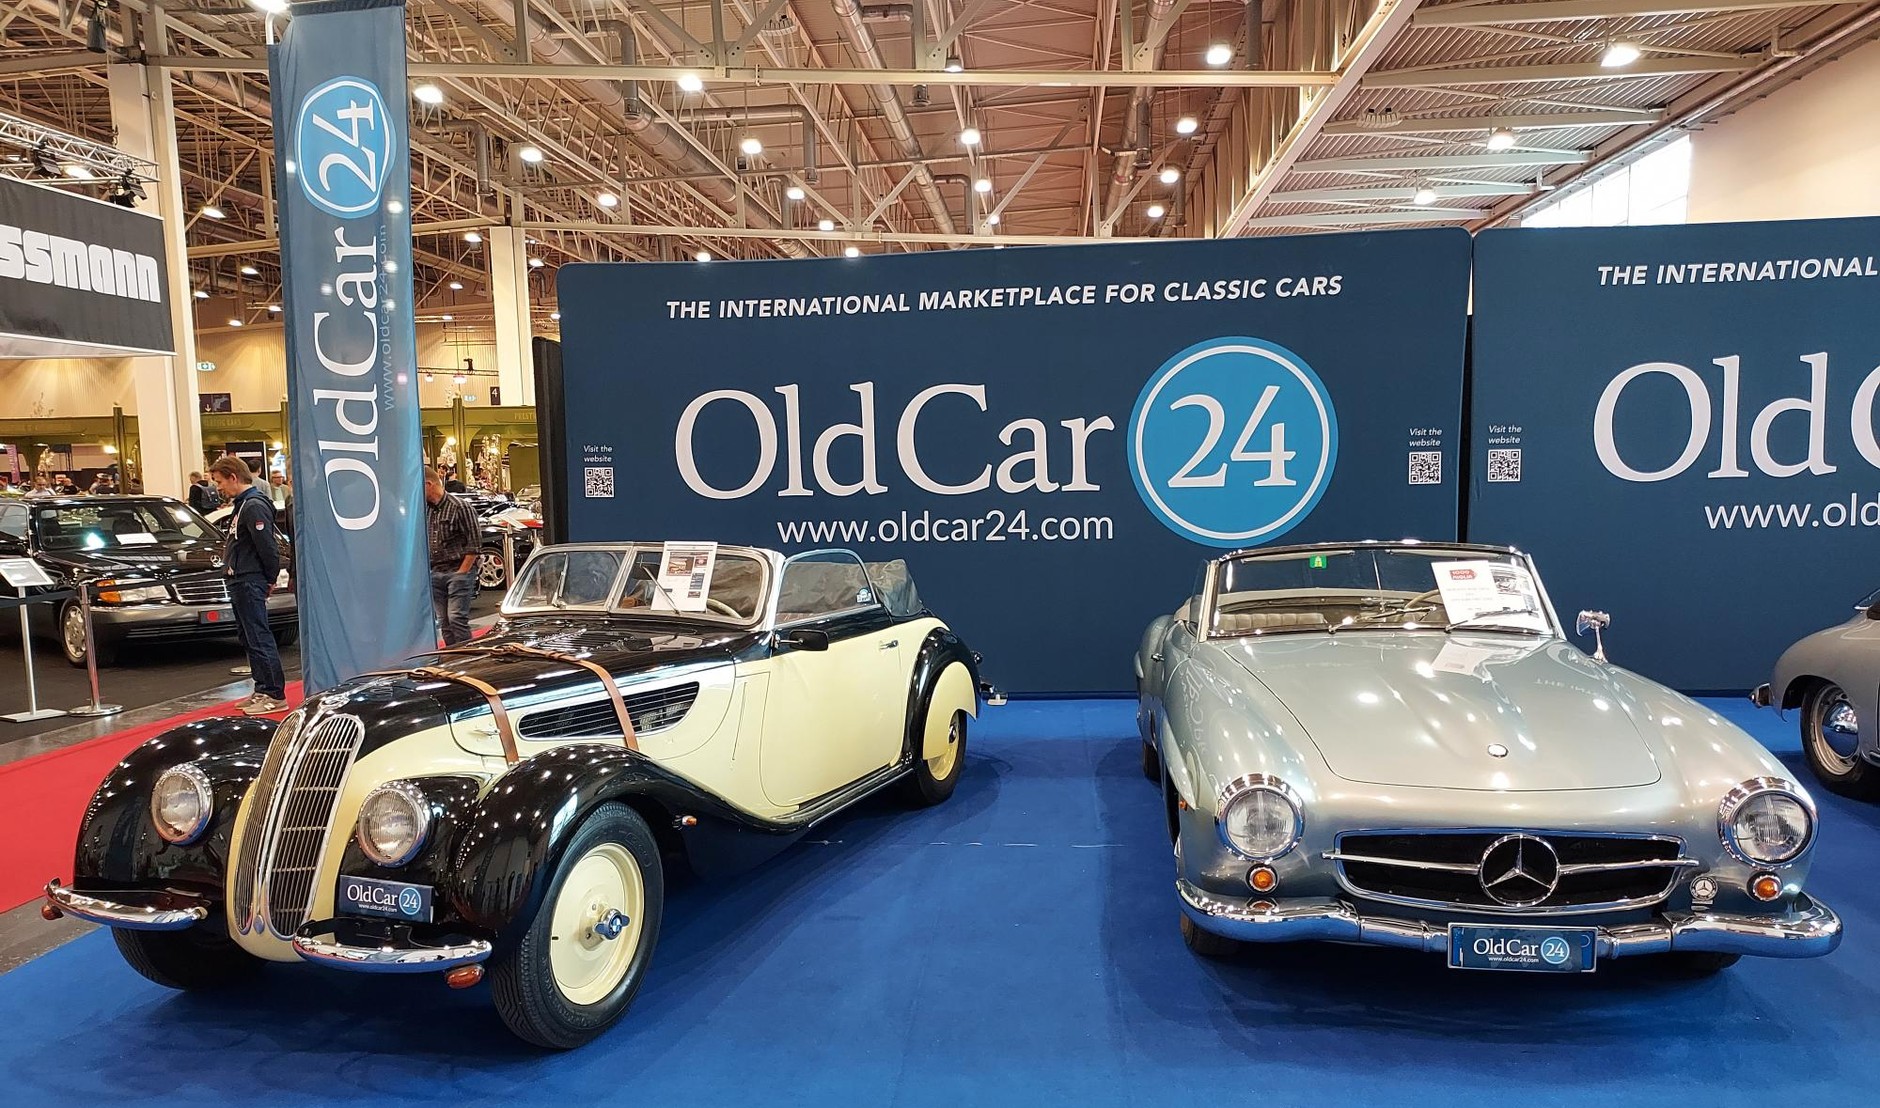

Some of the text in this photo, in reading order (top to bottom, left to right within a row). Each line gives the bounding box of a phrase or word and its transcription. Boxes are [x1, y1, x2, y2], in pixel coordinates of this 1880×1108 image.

[312, 98, 377, 193] 24
[1597, 256, 1878, 286] THE INTERNATIONAL
[666, 275, 1343, 319] THE INTERNATIONAL MARKETPLACE FOR CLASSIC CARS
[491, 387, 498, 398] 4
[1593, 351, 1880, 482] Old
[1409, 427, 1443, 436] Visit the
[1489, 424, 1522, 433] Visit the
[1167, 385, 1298, 488] 24
[1488, 436, 1521, 445] website
[1409, 438, 1441, 447] website
[583, 444, 613, 453] Visit the
[583, 454, 613, 463] website
[776, 509, 1114, 543] www.oldcar24.com
[402, 893, 418, 909] 24
[358, 903, 398, 913] www.oldcar24.com
[1545, 942, 1565, 958] 24
[1488, 956, 1540, 964] www.oldcar24.com
